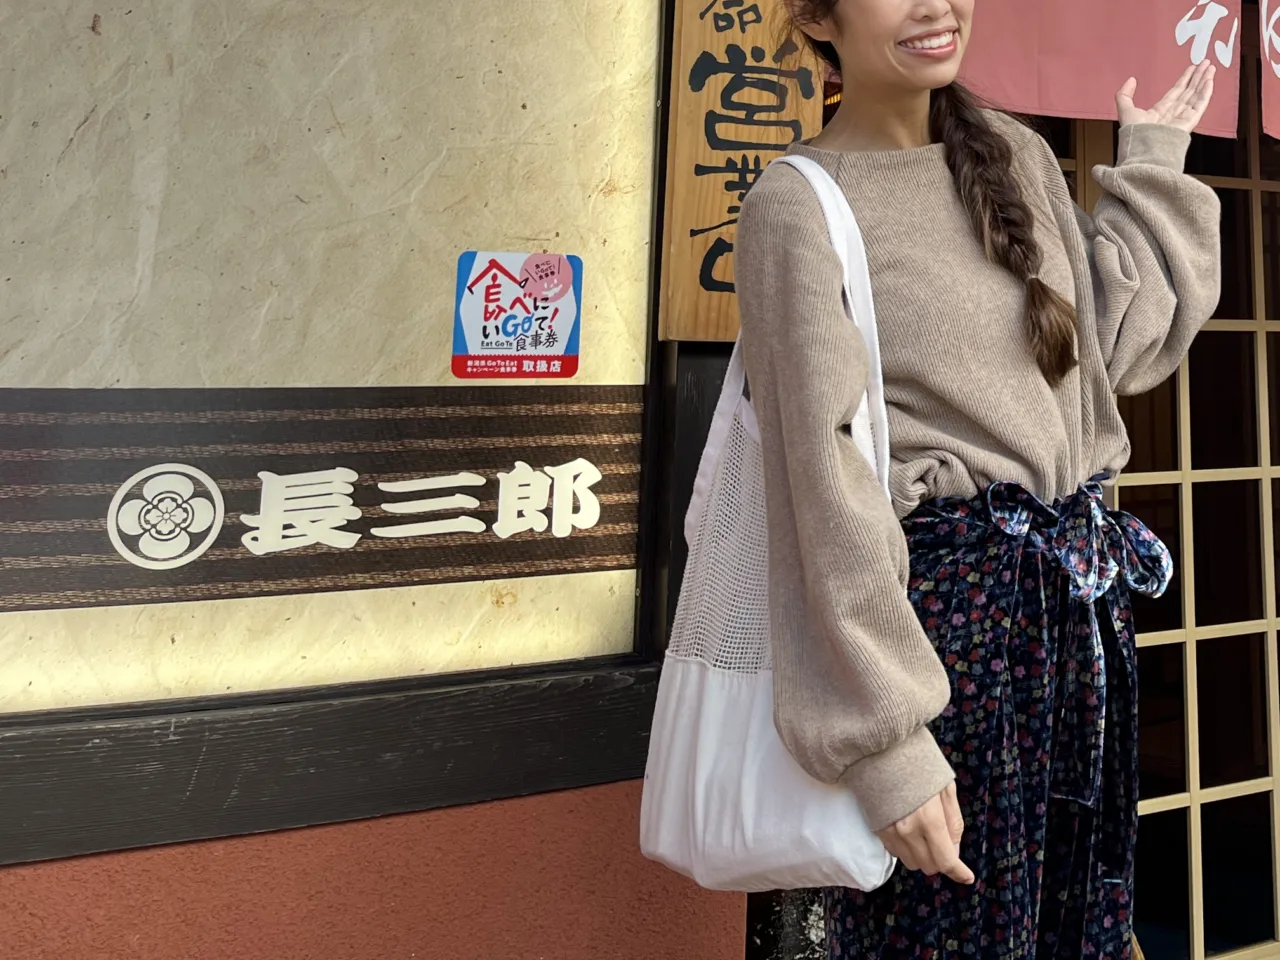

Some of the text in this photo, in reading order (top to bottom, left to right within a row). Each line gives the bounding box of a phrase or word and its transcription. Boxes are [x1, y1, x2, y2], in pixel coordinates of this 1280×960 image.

[481, 340, 493, 348] Eat
[513, 329, 559, 352] 食事券
[522, 360, 562, 373] 取扱店
[241, 457, 604, 556] 長三郎
